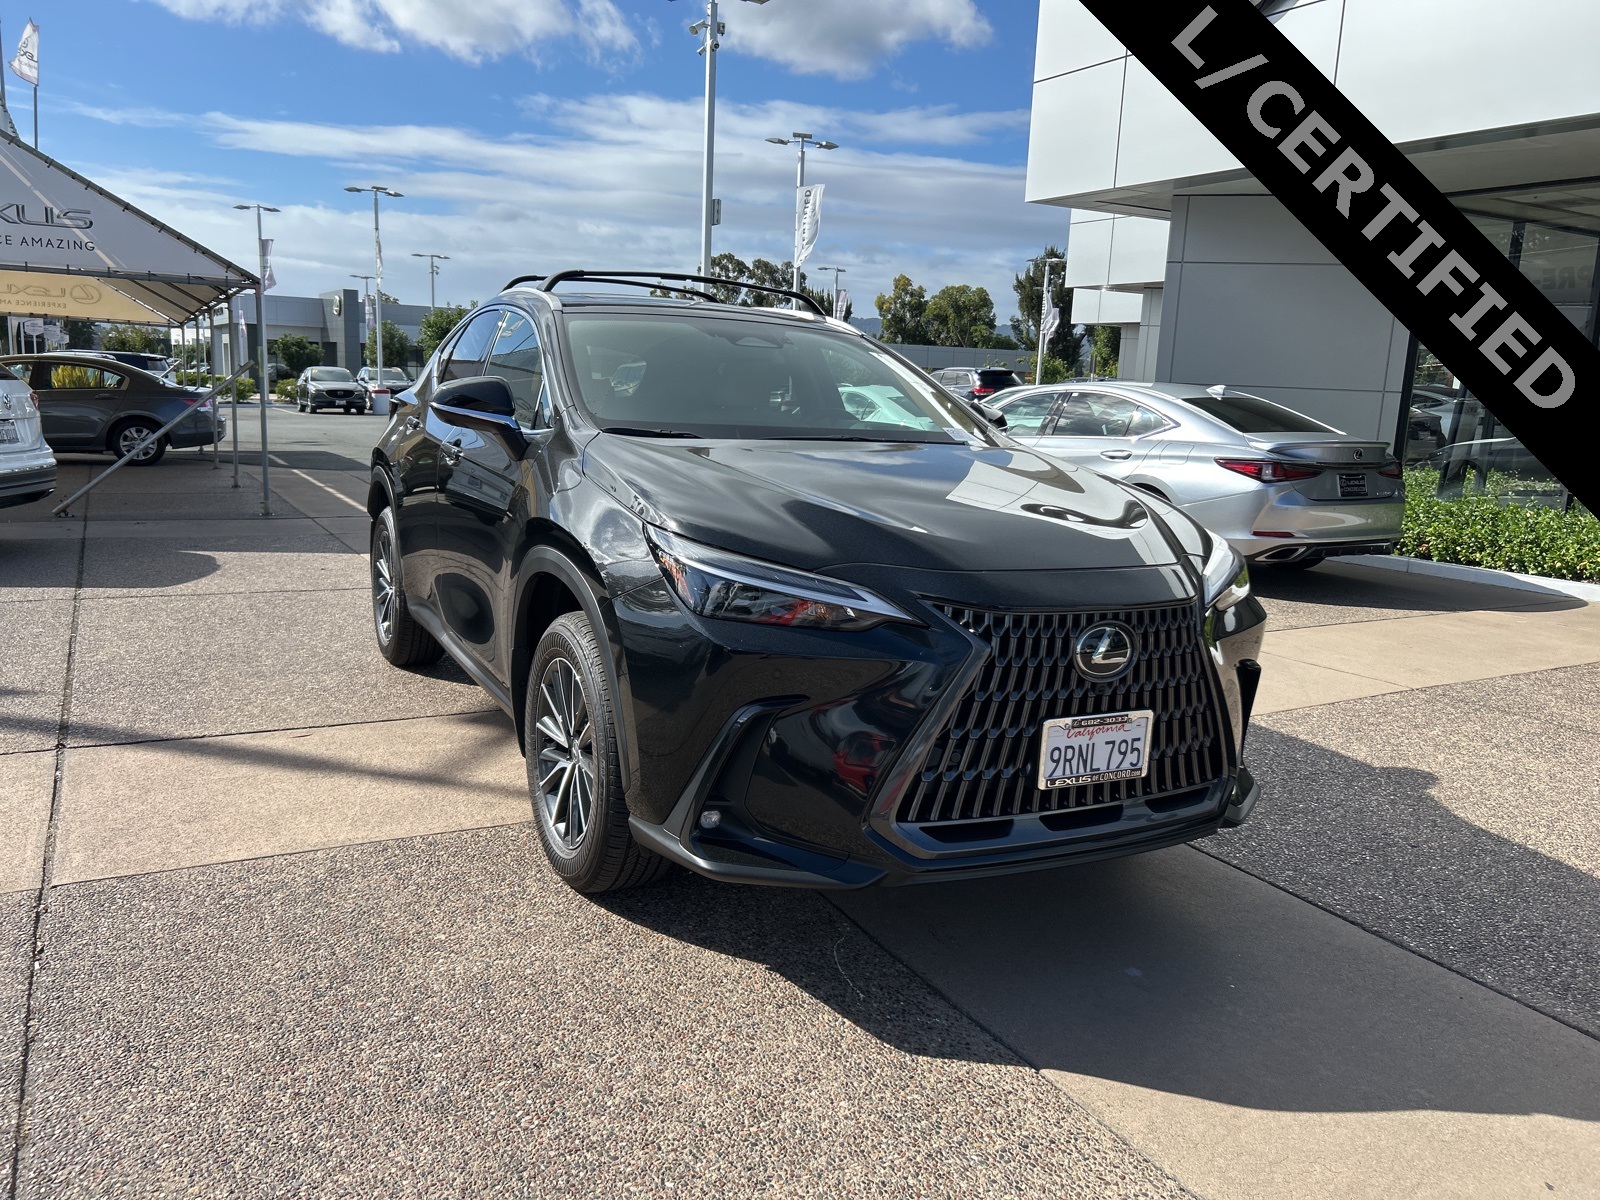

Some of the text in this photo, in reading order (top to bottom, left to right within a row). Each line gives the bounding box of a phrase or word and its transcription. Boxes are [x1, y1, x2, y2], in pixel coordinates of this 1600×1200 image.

[20, 236, 95, 252] AMAZING
[1081, 716, 1129, 726] 682-3033
[1066, 724, 1131, 741] California
[1047, 775, 1092, 788] LEXUS
